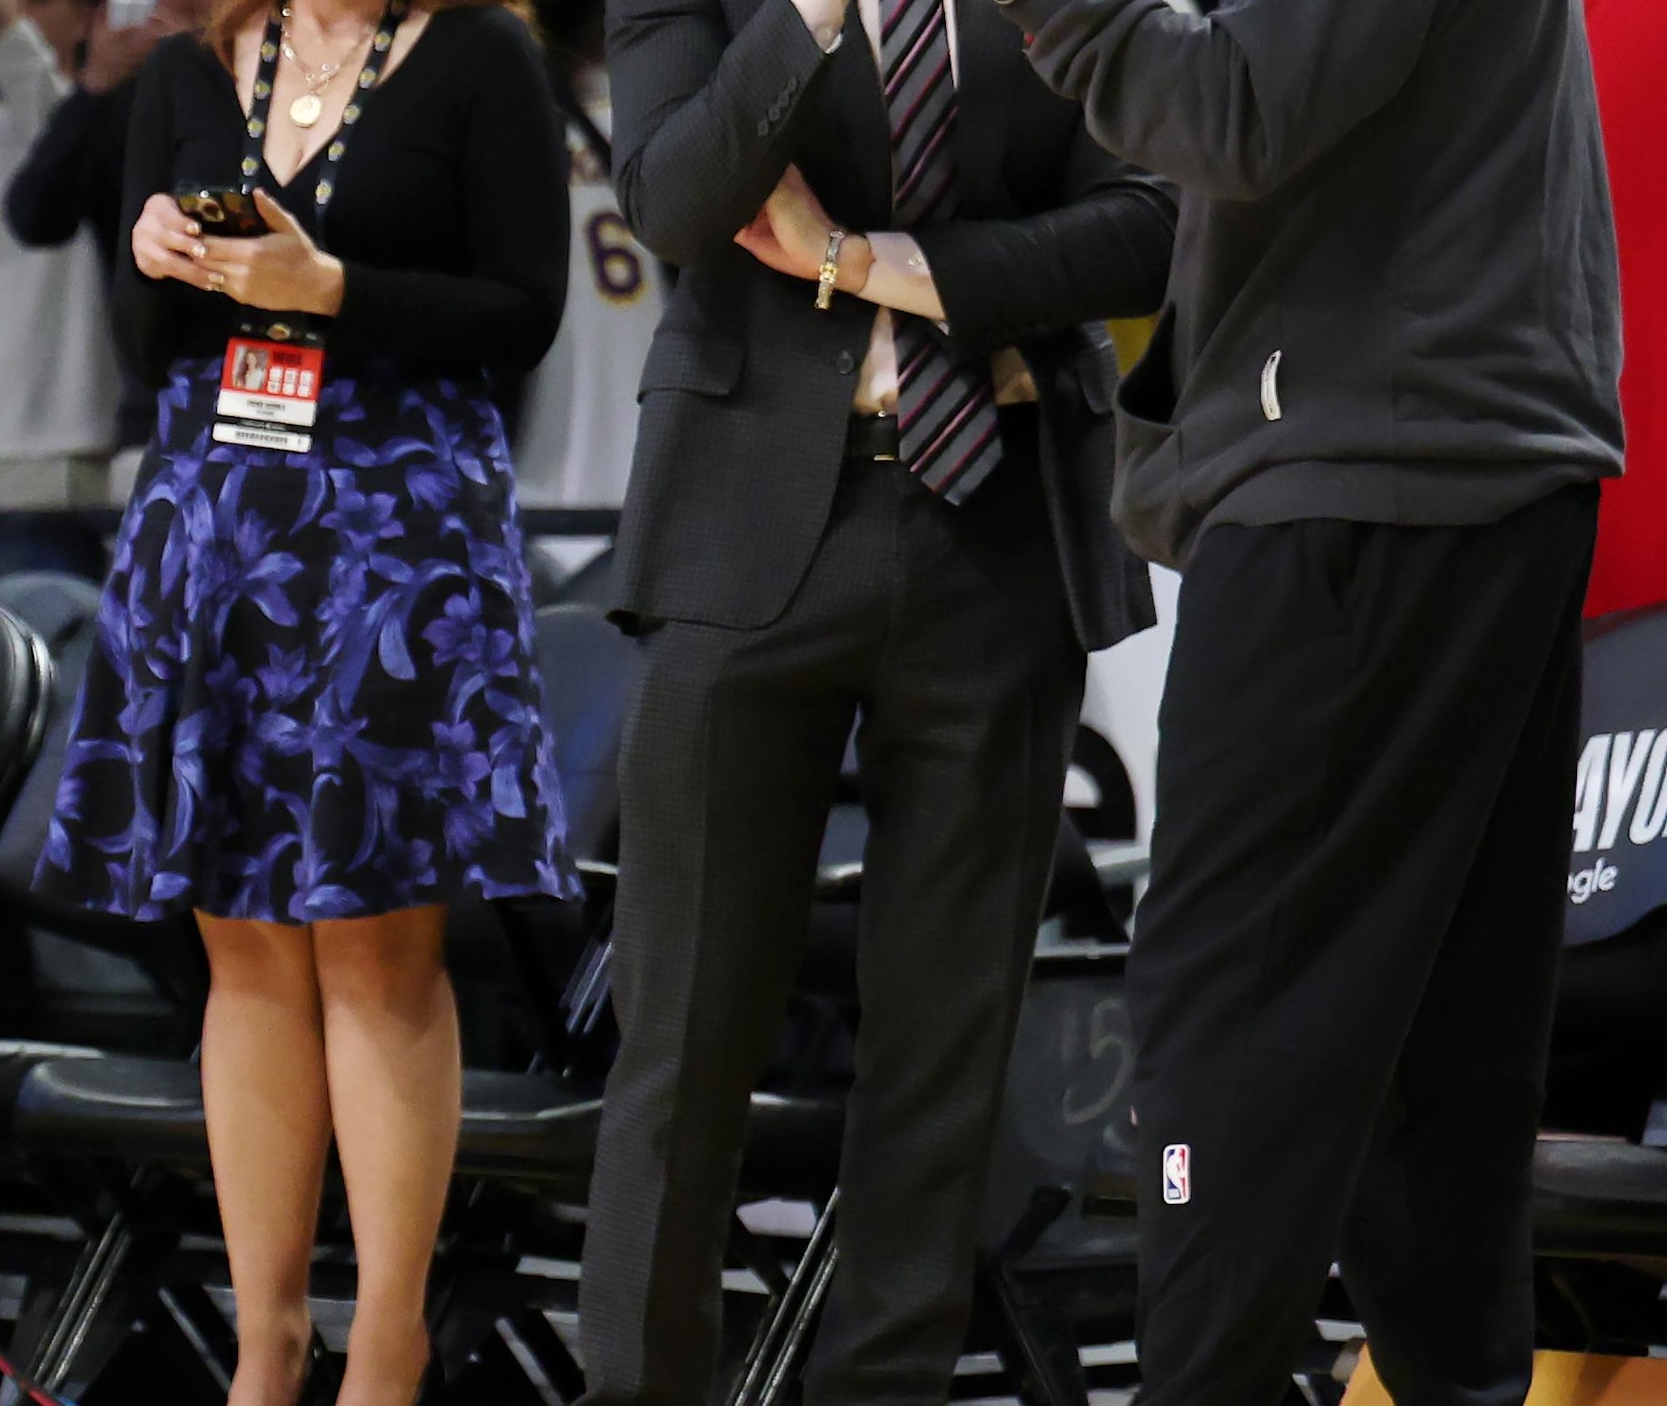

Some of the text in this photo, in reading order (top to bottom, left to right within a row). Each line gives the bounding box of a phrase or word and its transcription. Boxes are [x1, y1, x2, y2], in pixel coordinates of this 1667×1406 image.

[587, 210, 645, 302] 6
[1572, 728, 1667, 850] AYO
[1567, 857, 1618, 904] gle
